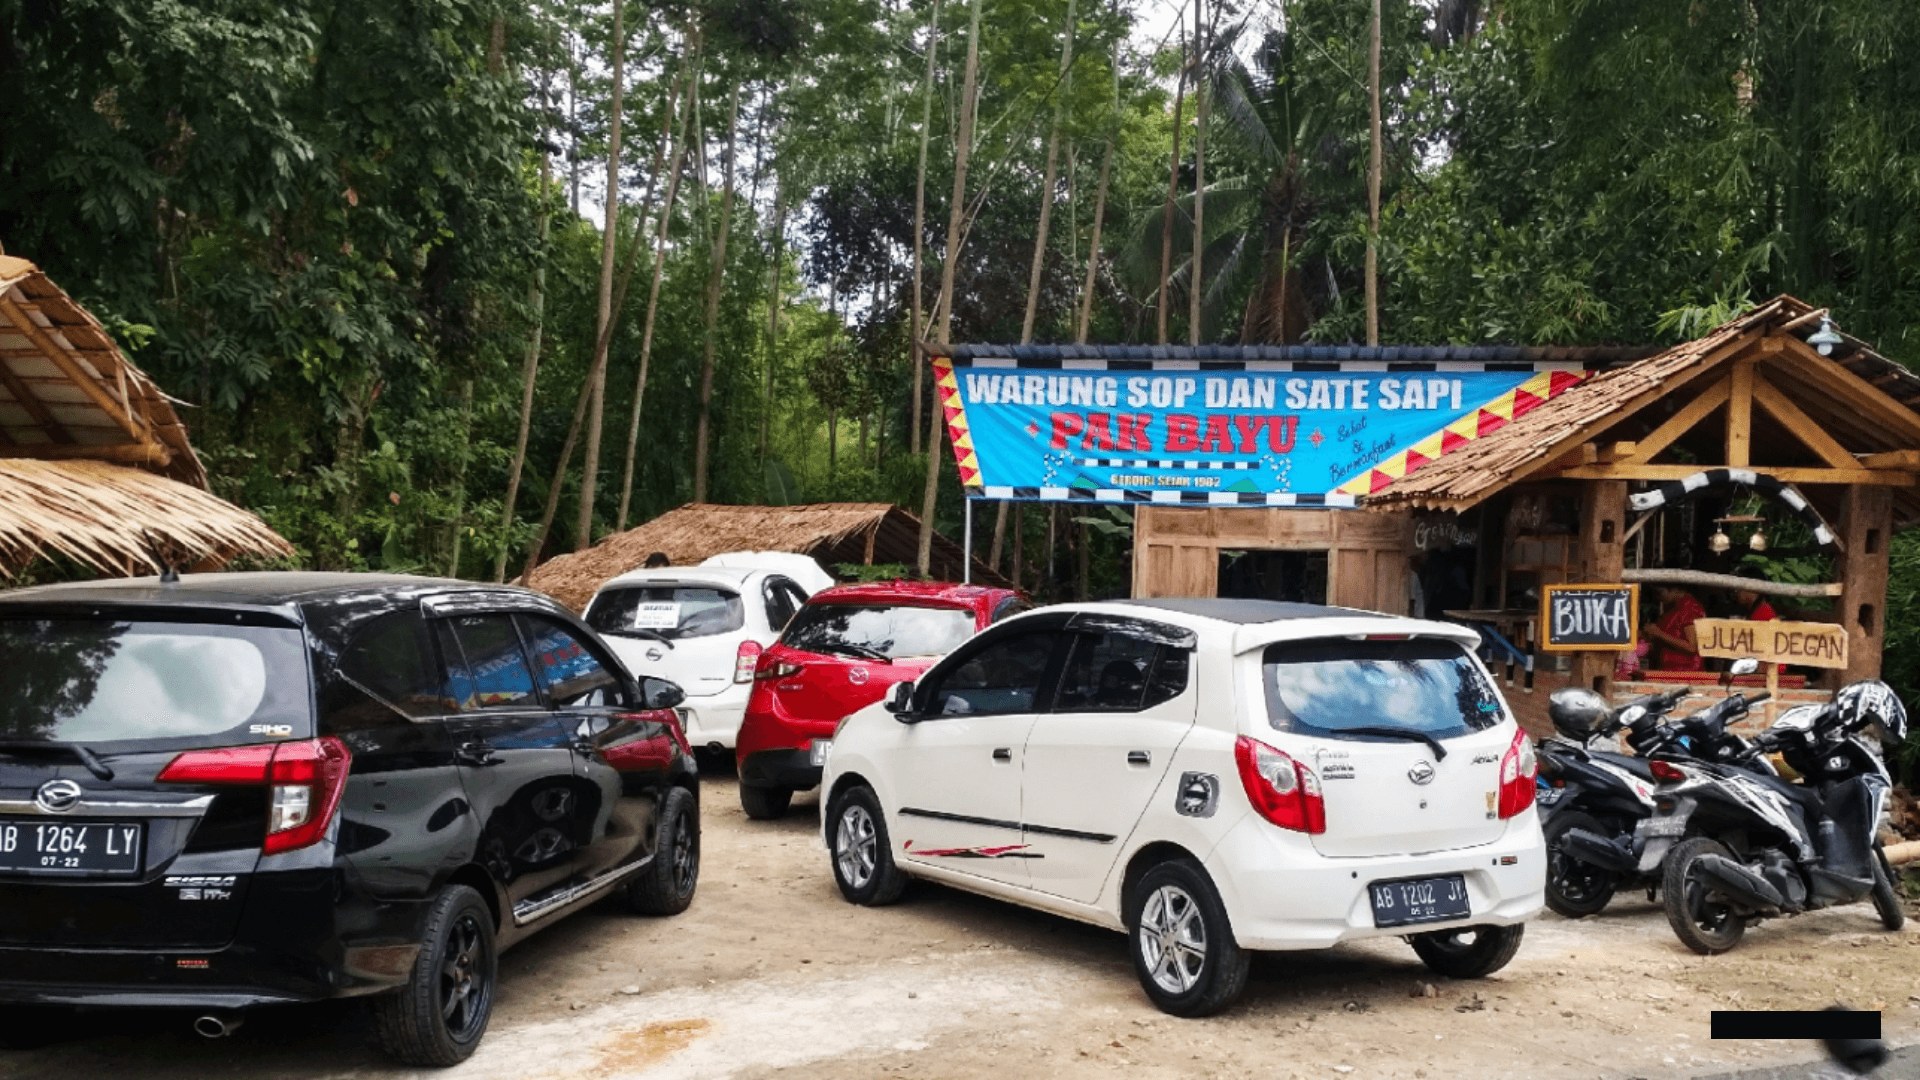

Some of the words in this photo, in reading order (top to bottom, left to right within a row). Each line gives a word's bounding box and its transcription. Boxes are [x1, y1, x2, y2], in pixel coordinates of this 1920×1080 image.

[966, 373, 1117, 406] WARUNG
[1127, 377, 1196, 408] SOP
[1205, 378, 1276, 409] DAN
[1285, 379, 1370, 410] SATE
[1378, 379, 1462, 410] SAPI
[1050, 412, 1152, 450] PAK
[1164, 414, 1299, 453] BAYU
[1554, 598, 1630, 639] BUKA
[1703, 626, 1764, 653] JUAL
[1774, 631, 1844, 661] DEGAN
[37, 825, 87, 853] 1264
[106, 828, 135, 855] LY
[1376, 887, 1394, 908] AB
[1401, 883, 1436, 906] 1202
